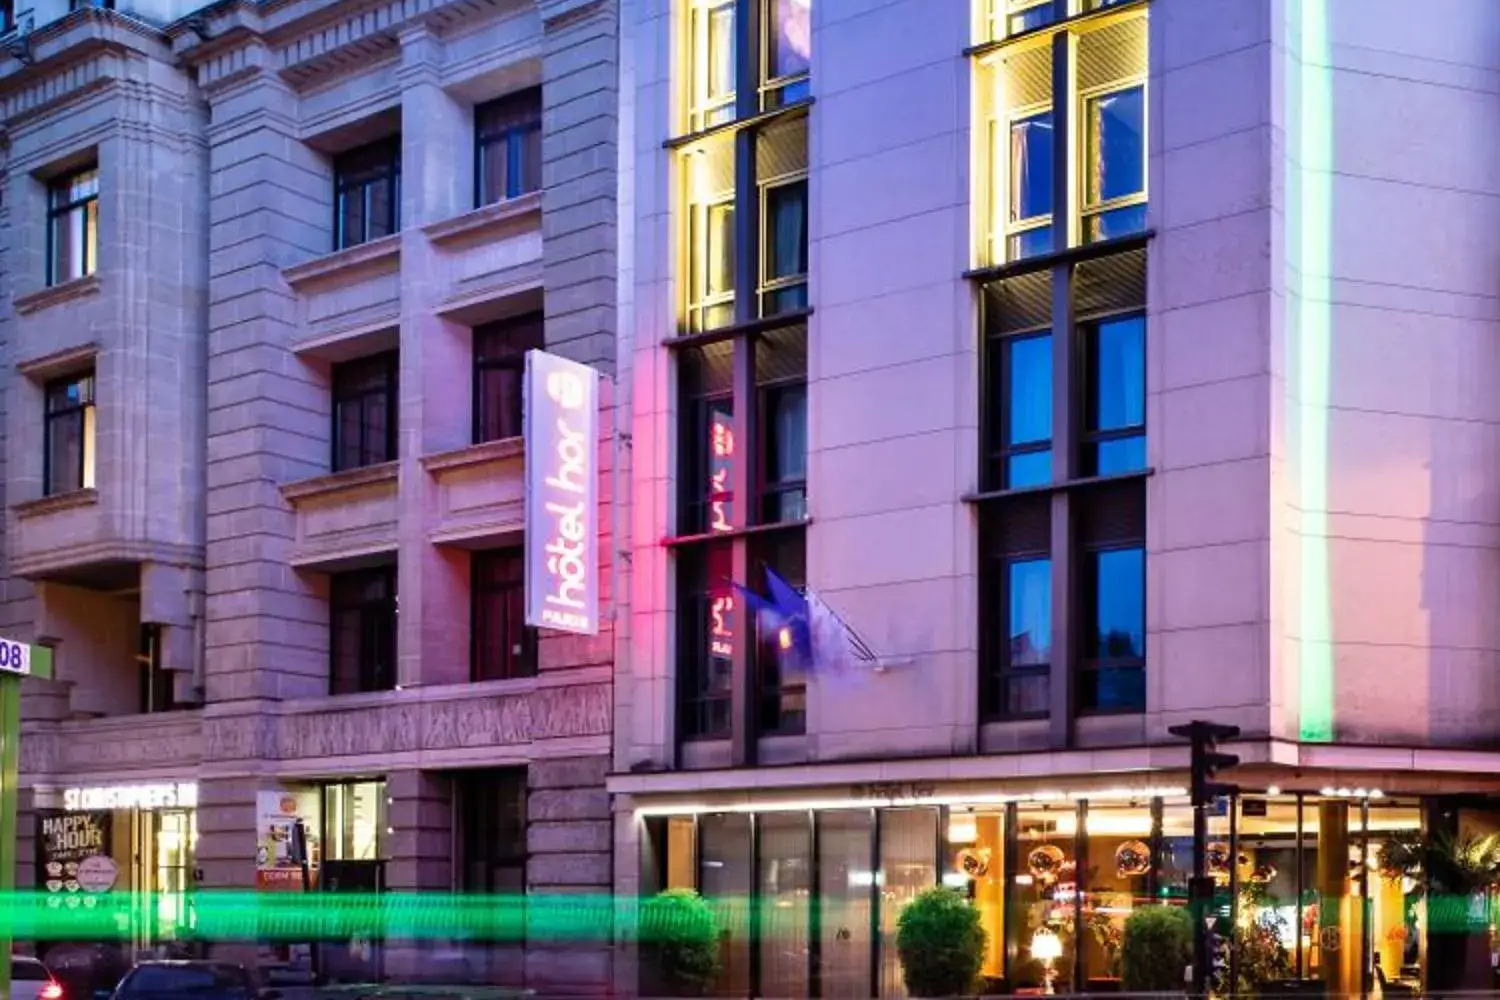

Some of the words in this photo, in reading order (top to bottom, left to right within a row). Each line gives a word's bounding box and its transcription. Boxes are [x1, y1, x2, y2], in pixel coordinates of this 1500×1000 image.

[545, 416, 585, 493] hor
[545, 501, 586, 608] hôtel
[43, 813, 92, 835] HAPPY
[57, 829, 102, 850] HOUR
